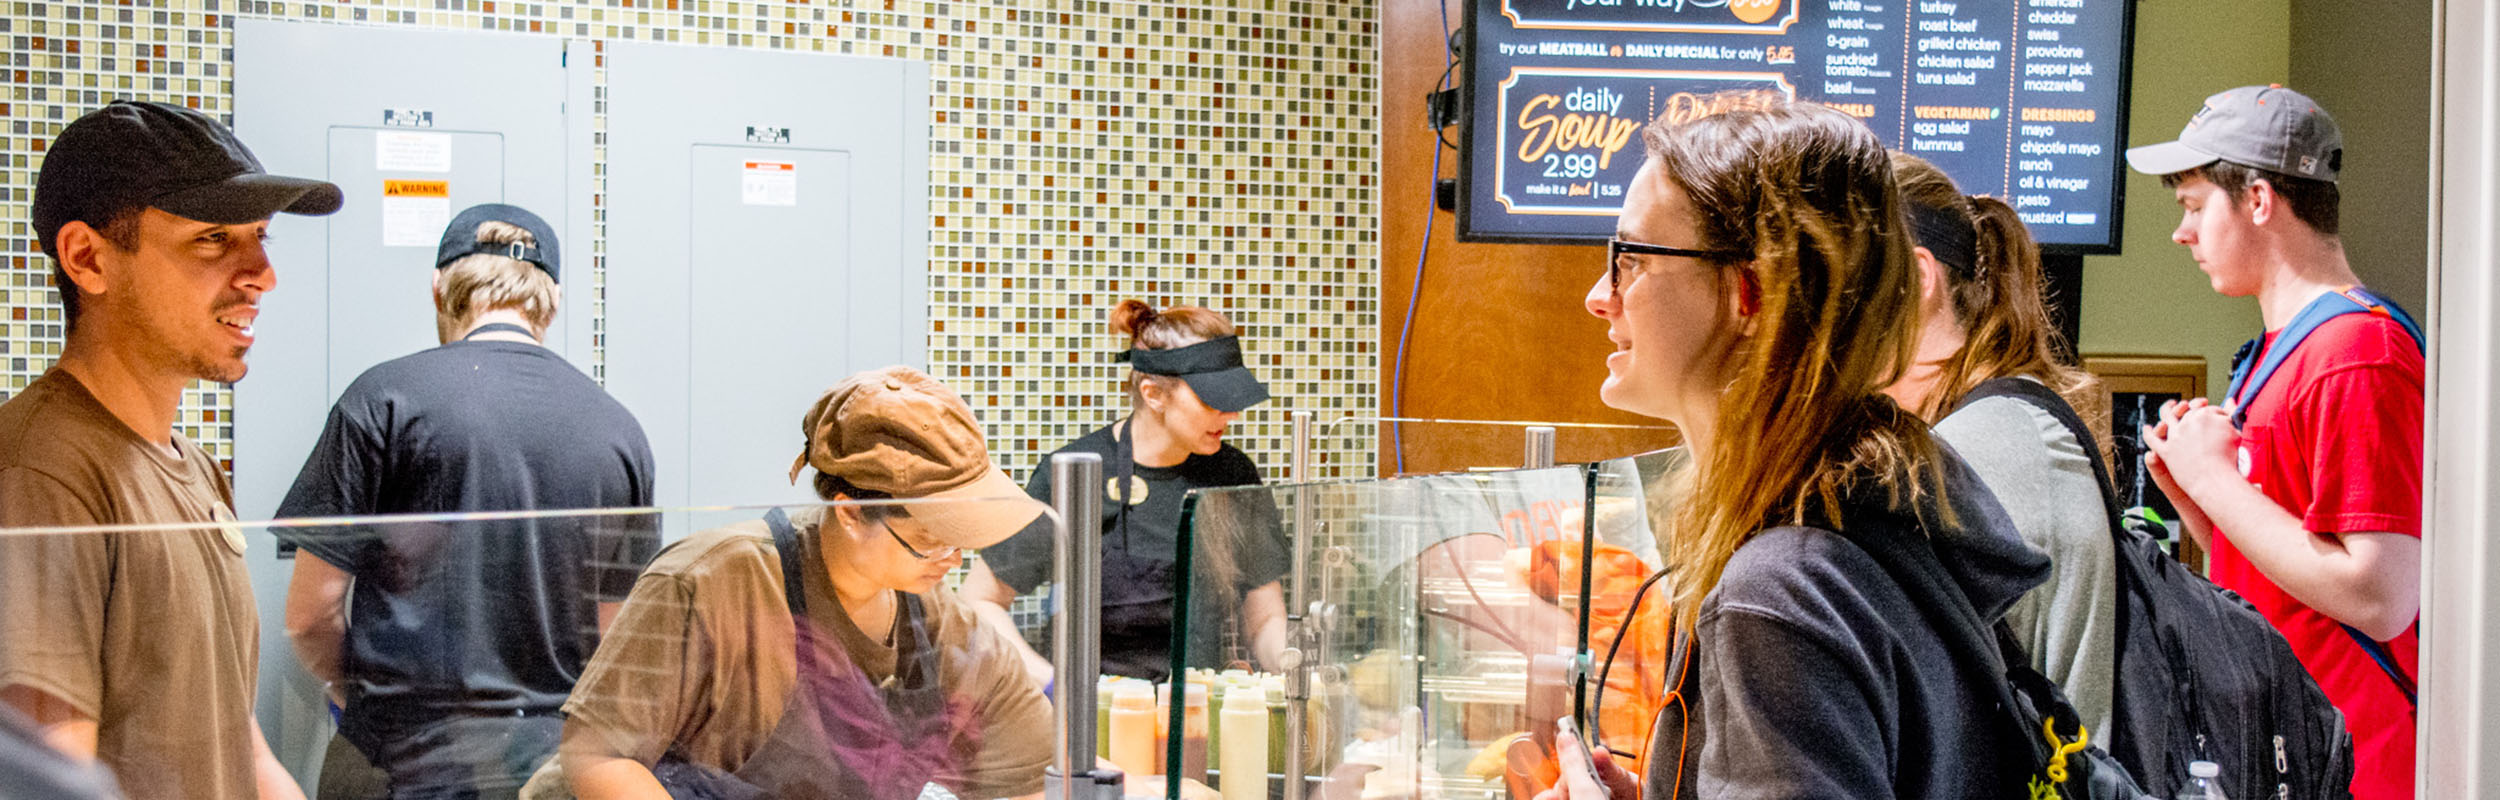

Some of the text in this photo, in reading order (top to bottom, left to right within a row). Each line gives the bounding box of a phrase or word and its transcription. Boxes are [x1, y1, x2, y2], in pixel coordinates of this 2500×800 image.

[1828, 0, 1862, 11] white
[1920, 0, 1957, 16] turkey
[1827, 16, 1864, 30] wheat
[2028, 9, 2078, 25] cheddar
[1919, 18, 1978, 32] roast beef
[1826, 34, 1869, 49] 9-grain
[2027, 28, 2059, 41] swiss
[1917, 36, 2001, 52] grilled chicken
[2025, 44, 2084, 59] provolone
[1499, 42, 1516, 56] try
[1517, 44, 1538, 55] our
[1539, 42, 1608, 56] MEATBALL
[1626, 44, 1664, 58] DAILY
[1664, 46, 1720, 60] SPECIAL
[1720, 46, 1737, 59] for
[1738, 48, 1764, 62] only
[1825, 52, 1878, 66] sundried
[1917, 54, 1995, 69] chicken salad
[2025, 61, 2093, 77] pepper jack
[1825, 65, 1868, 76] tomato
[1916, 71, 1976, 85] tuna salad
[1824, 80, 1852, 94] basil
[2023, 78, 2085, 92] mozzarella
[1565, 87, 1623, 116] daily
[1914, 105, 1991, 120] VEGETARIAN
[2021, 107, 2096, 123] DRESSINGS
[1518, 93, 1642, 170] Soup
[1913, 120, 1970, 136] egg salad
[2021, 125, 2055, 138] mayo
[1912, 137, 1965, 152] hummus
[2020, 140, 2101, 157] chipotle mayo
[1543, 154, 1597, 179] 2.99
[2019, 158, 2053, 171] ranch
[401, 184, 446, 195] WARNING
[1526, 183, 1551, 194] make
[2019, 175, 2089, 192] oil & vinegar
[2017, 195, 2051, 208] pesto
[2018, 211, 2065, 224] mustard
